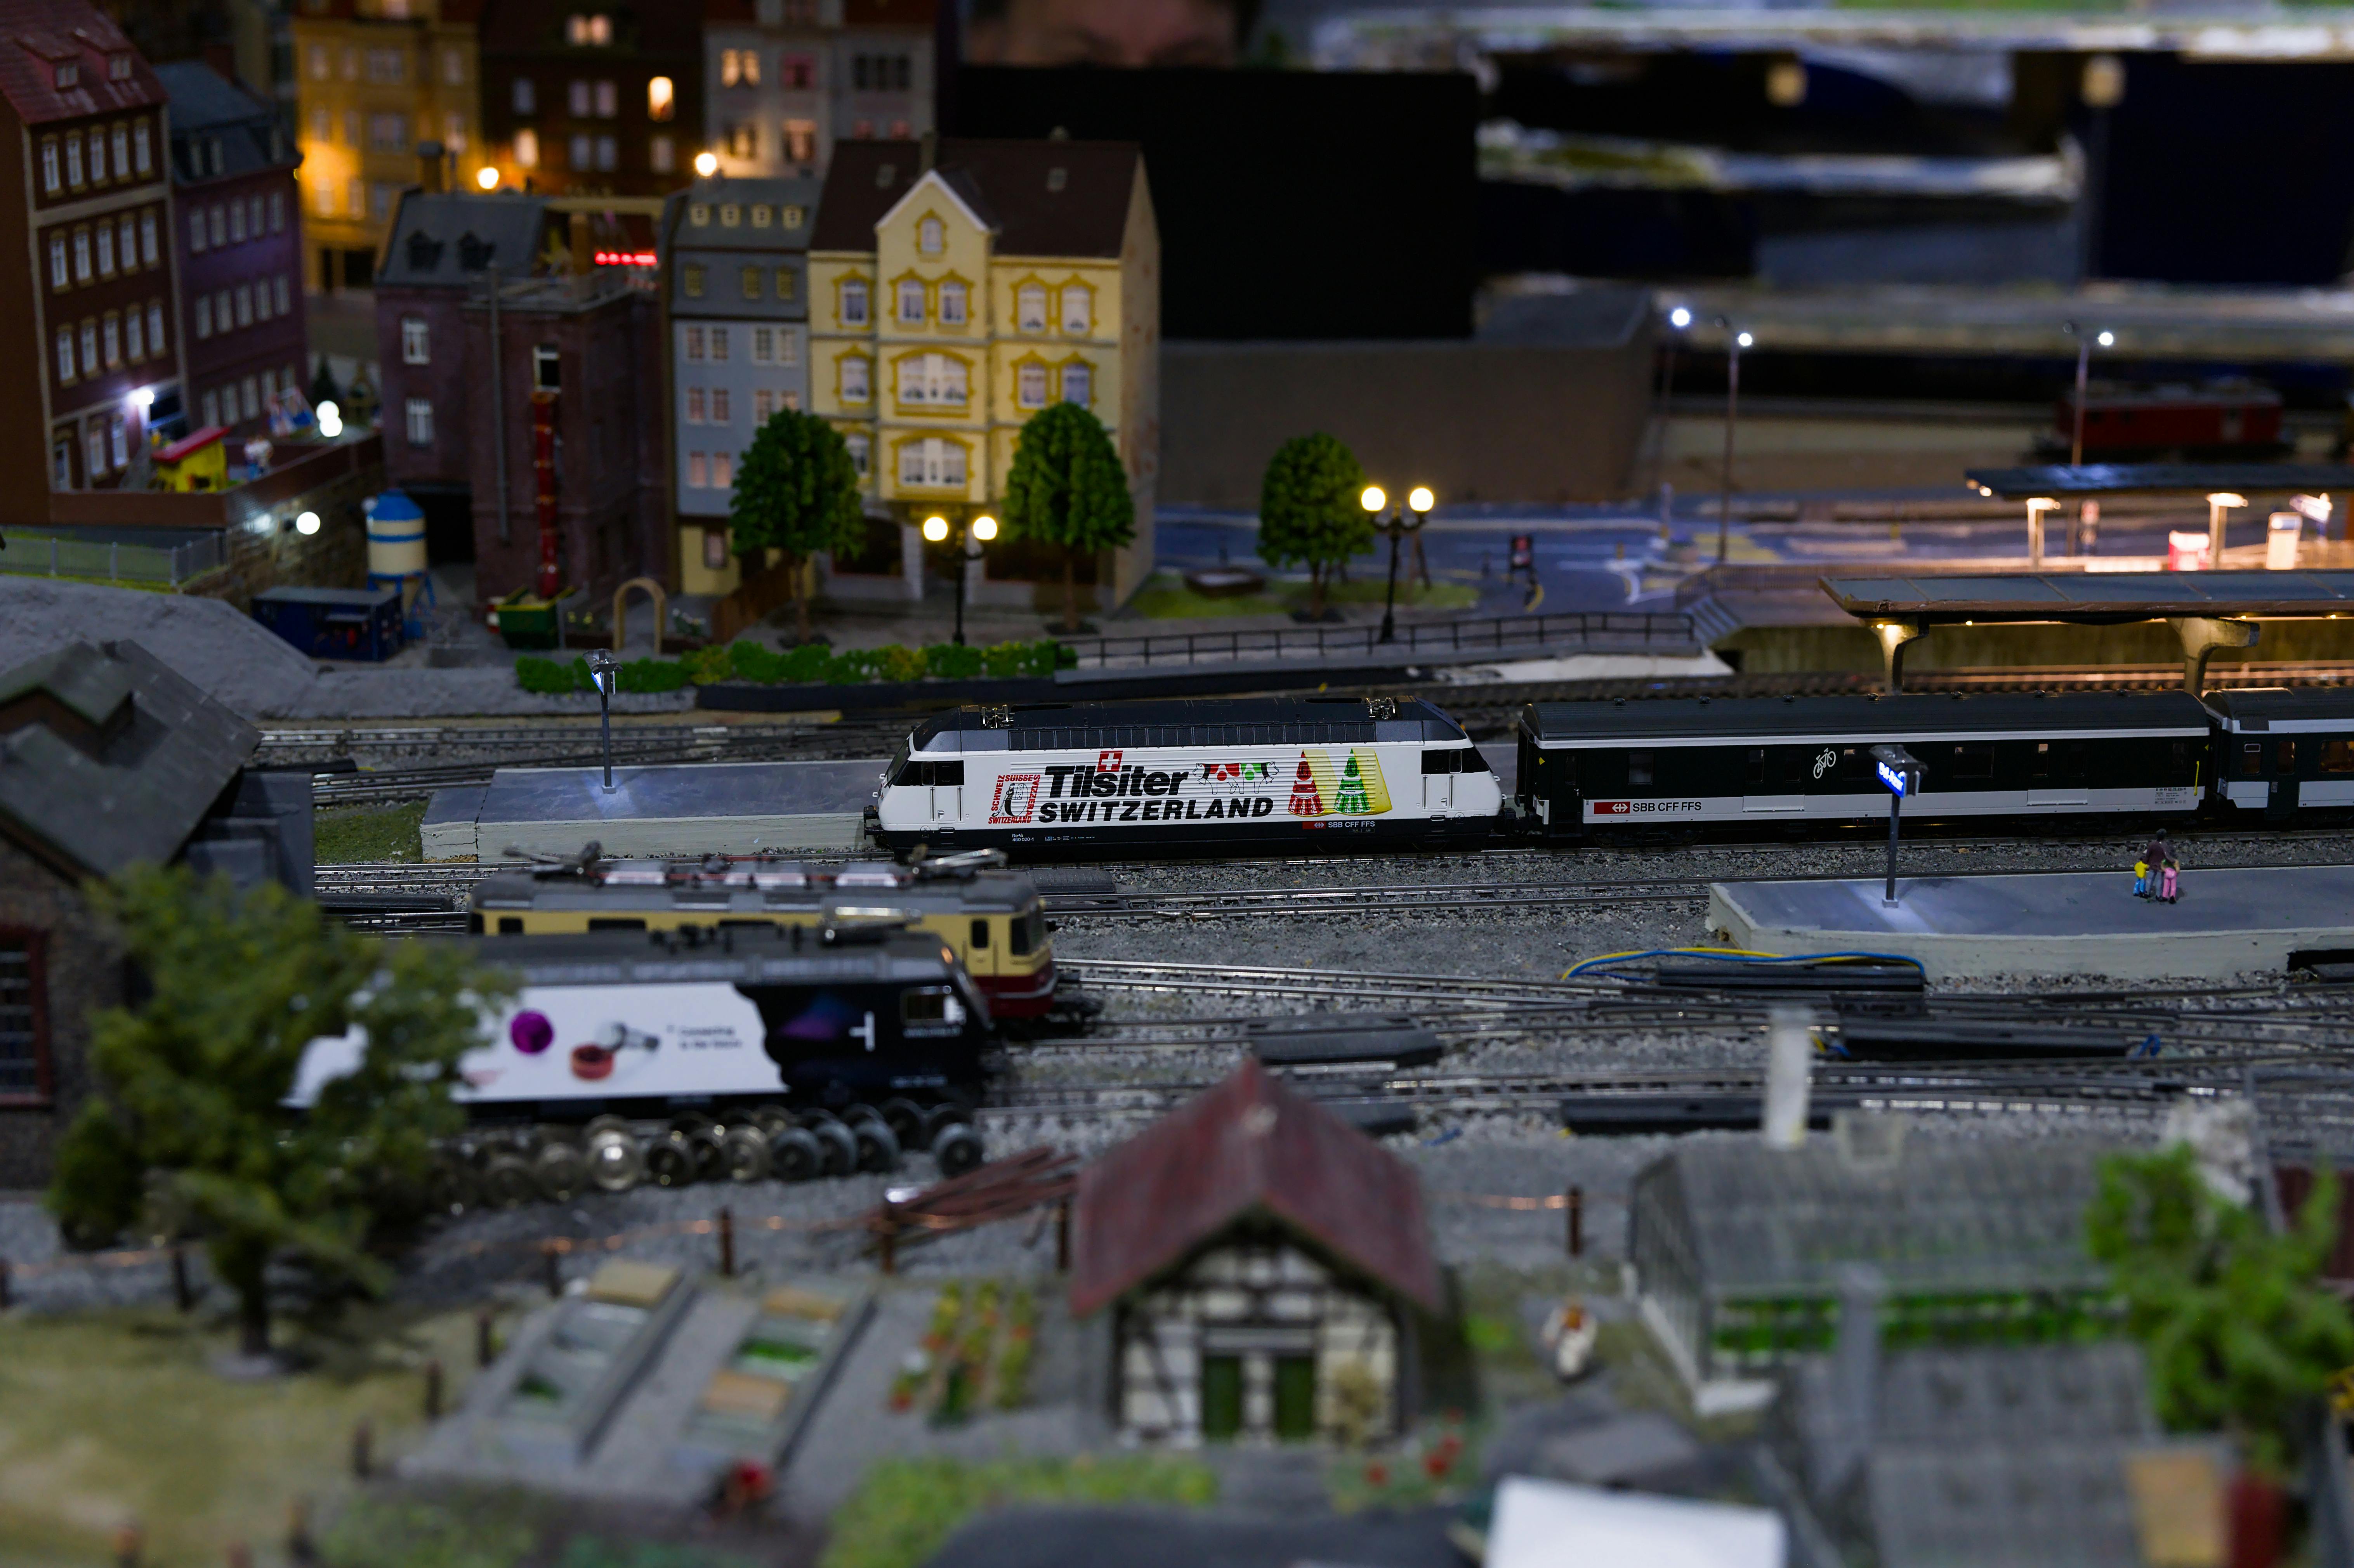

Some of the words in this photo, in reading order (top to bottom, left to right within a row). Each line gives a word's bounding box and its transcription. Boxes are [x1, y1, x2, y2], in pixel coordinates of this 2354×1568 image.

[991, 775, 1005, 811] SCHWEIZ
[1025, 774, 1041, 816] SVIZZERA
[1045, 765, 1189, 798] Tilsiter
[1038, 798, 1274, 823] SWITZERLAND
[1632, 803, 1655, 812] SBB
[1658, 802, 1679, 811] CFF
[1681, 801, 1702, 811] FFS
